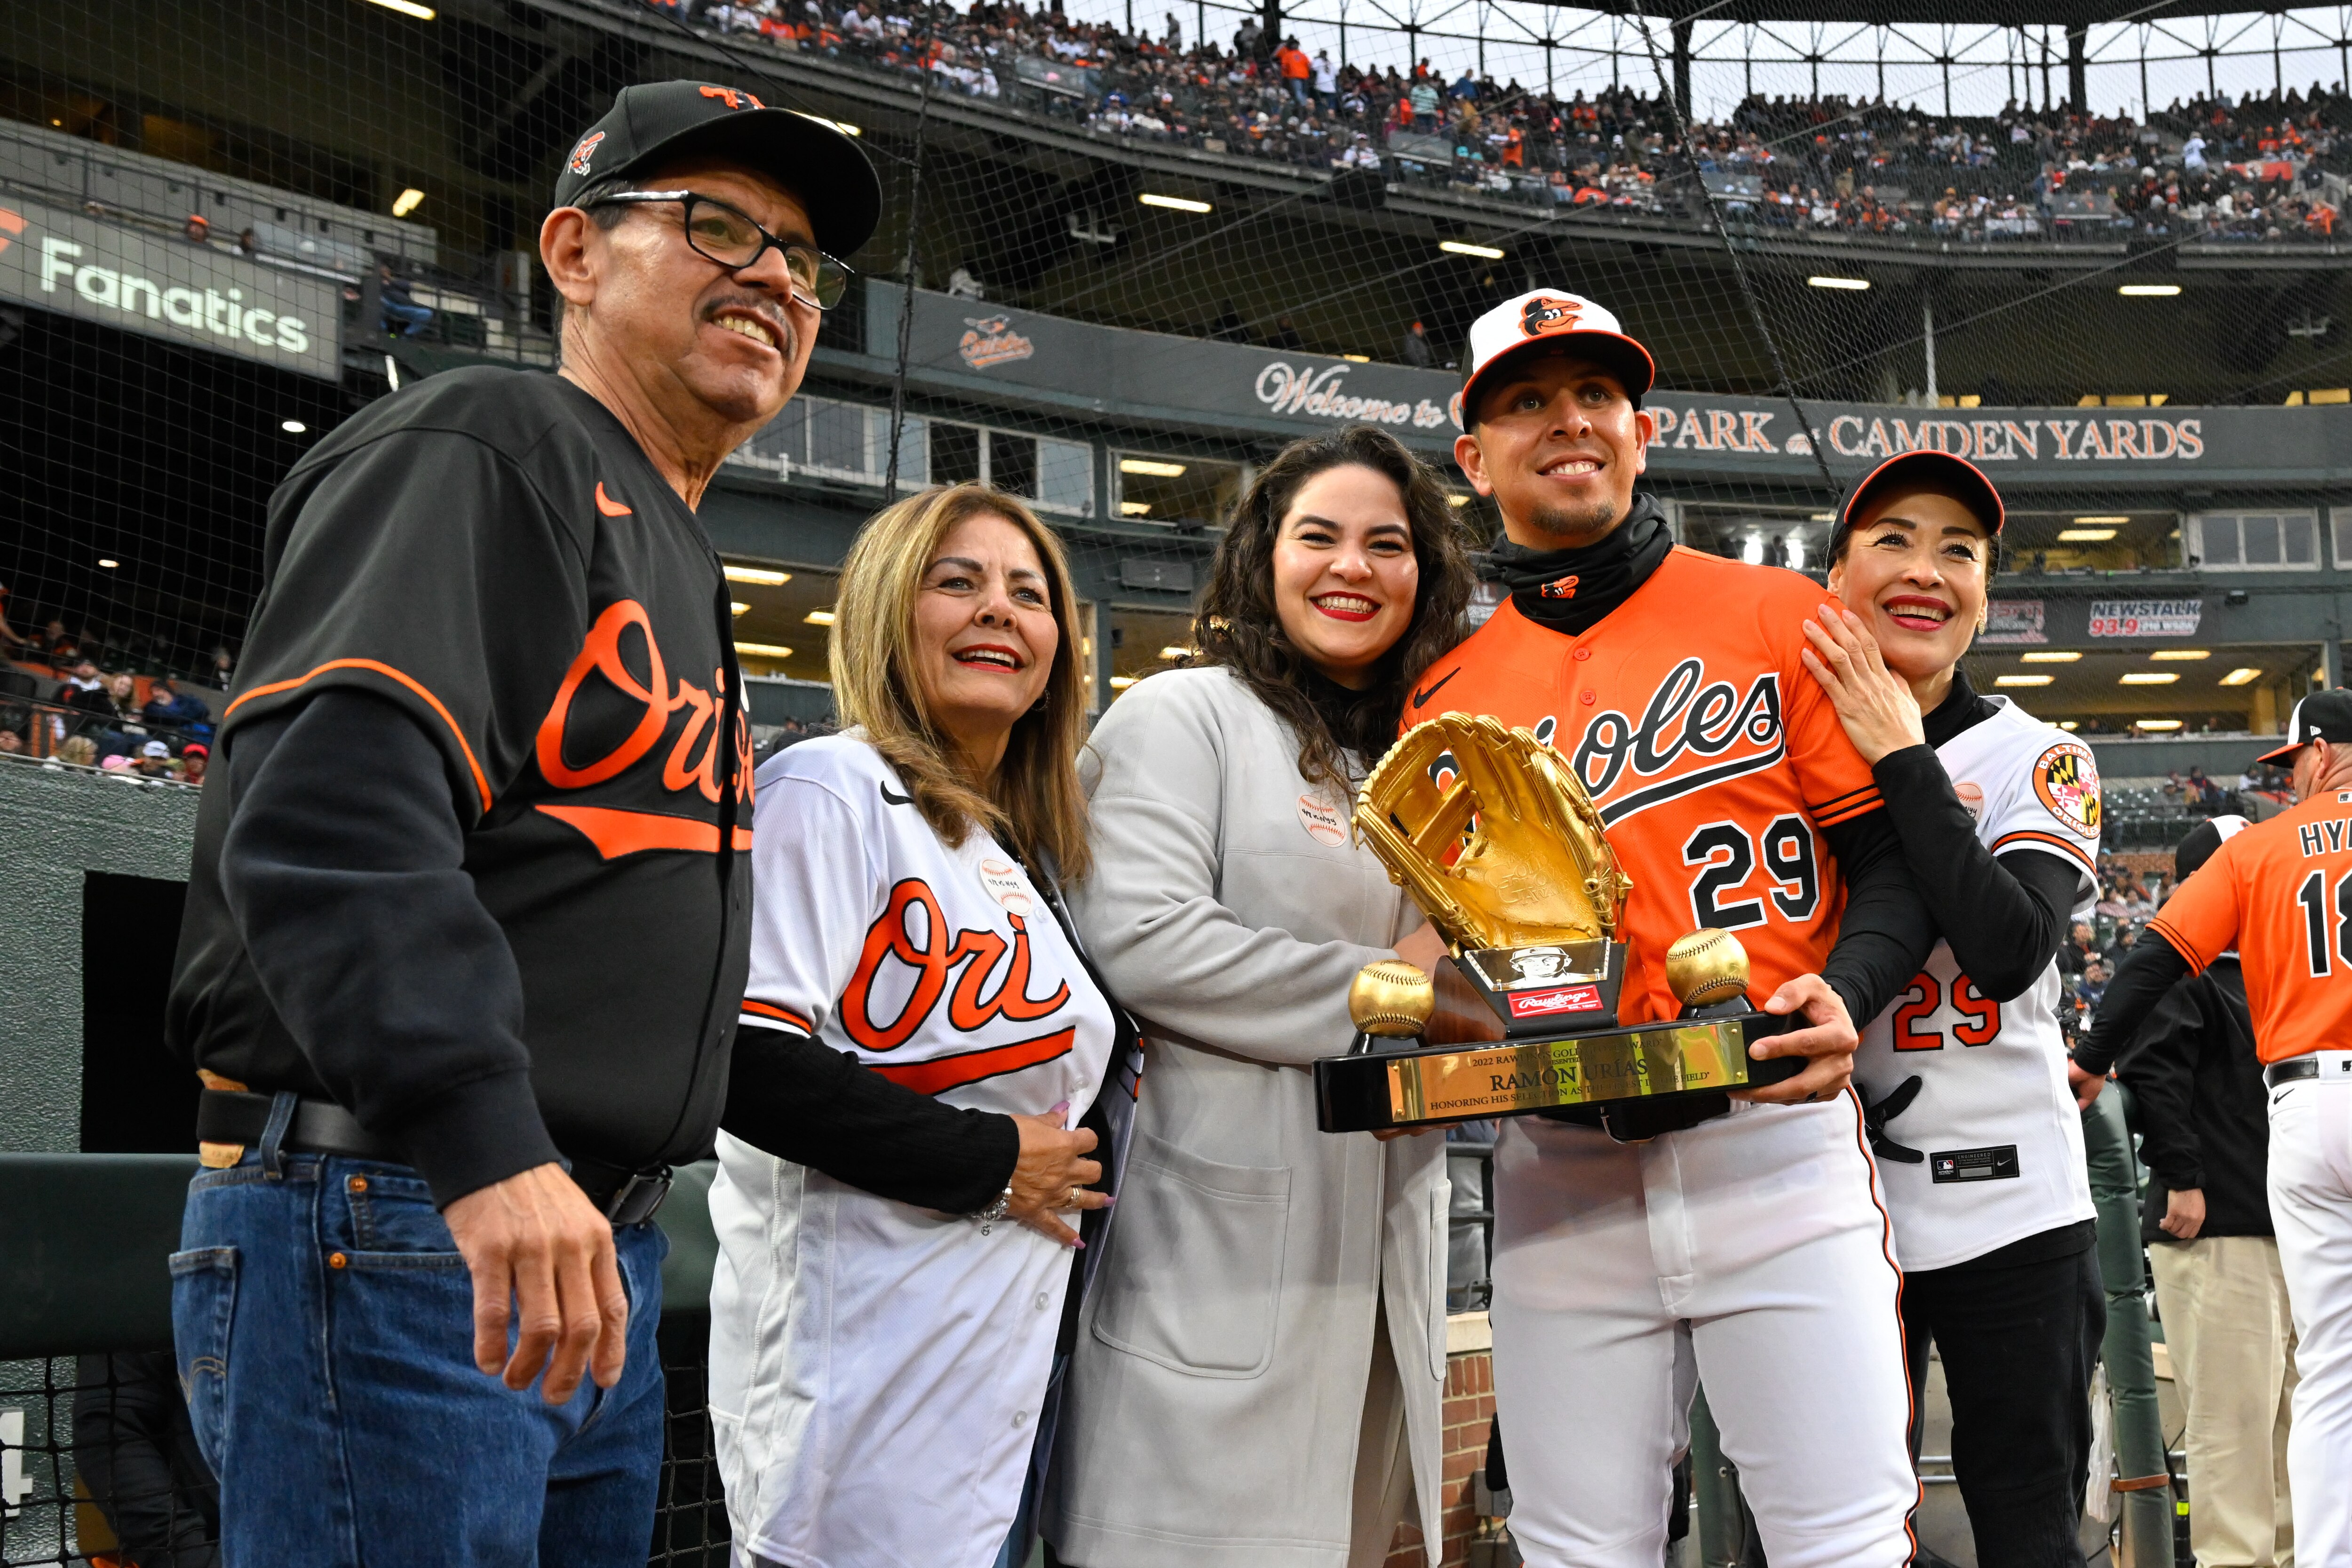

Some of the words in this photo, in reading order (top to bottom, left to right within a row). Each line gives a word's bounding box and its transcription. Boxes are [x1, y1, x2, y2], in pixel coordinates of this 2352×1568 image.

[40, 236, 310, 354] Fanatics
[1255, 361, 1411, 424] Welcome
[1413, 398, 1446, 428] to
[1645, 406, 1780, 454] PARK
[1828, 414, 2041, 460] CAMDEN
[2044, 419, 2204, 459] YARDS
[2091, 618, 2139, 634] 93.9
[2093, 601, 2202, 617] NEWSTALK
[2052, 806, 2100, 837] ORIOLES
[2298, 818, 2352, 858] HY
[1682, 813, 1820, 932] 29
[839, 877, 1071, 1052] Ori
[1518, 991, 1590, 1009] Rawlings
[1891, 969, 2002, 1052] 29
[1472, 1057, 1494, 1067] 2022
[1496, 1051, 1551, 1064] RAWLINGS
[1553, 1046, 1582, 1058] GOLD
[1489, 1064, 1576, 1092] RAMÓN
[1583, 1058, 1649, 1081] URÍAS
[1430, 1096, 1489, 1110] HONORING
[1491, 1094, 1509, 1104] HIS
[1510, 1088, 1568, 1102] SELECTION
[1570, 1086, 1583, 1095] AS
